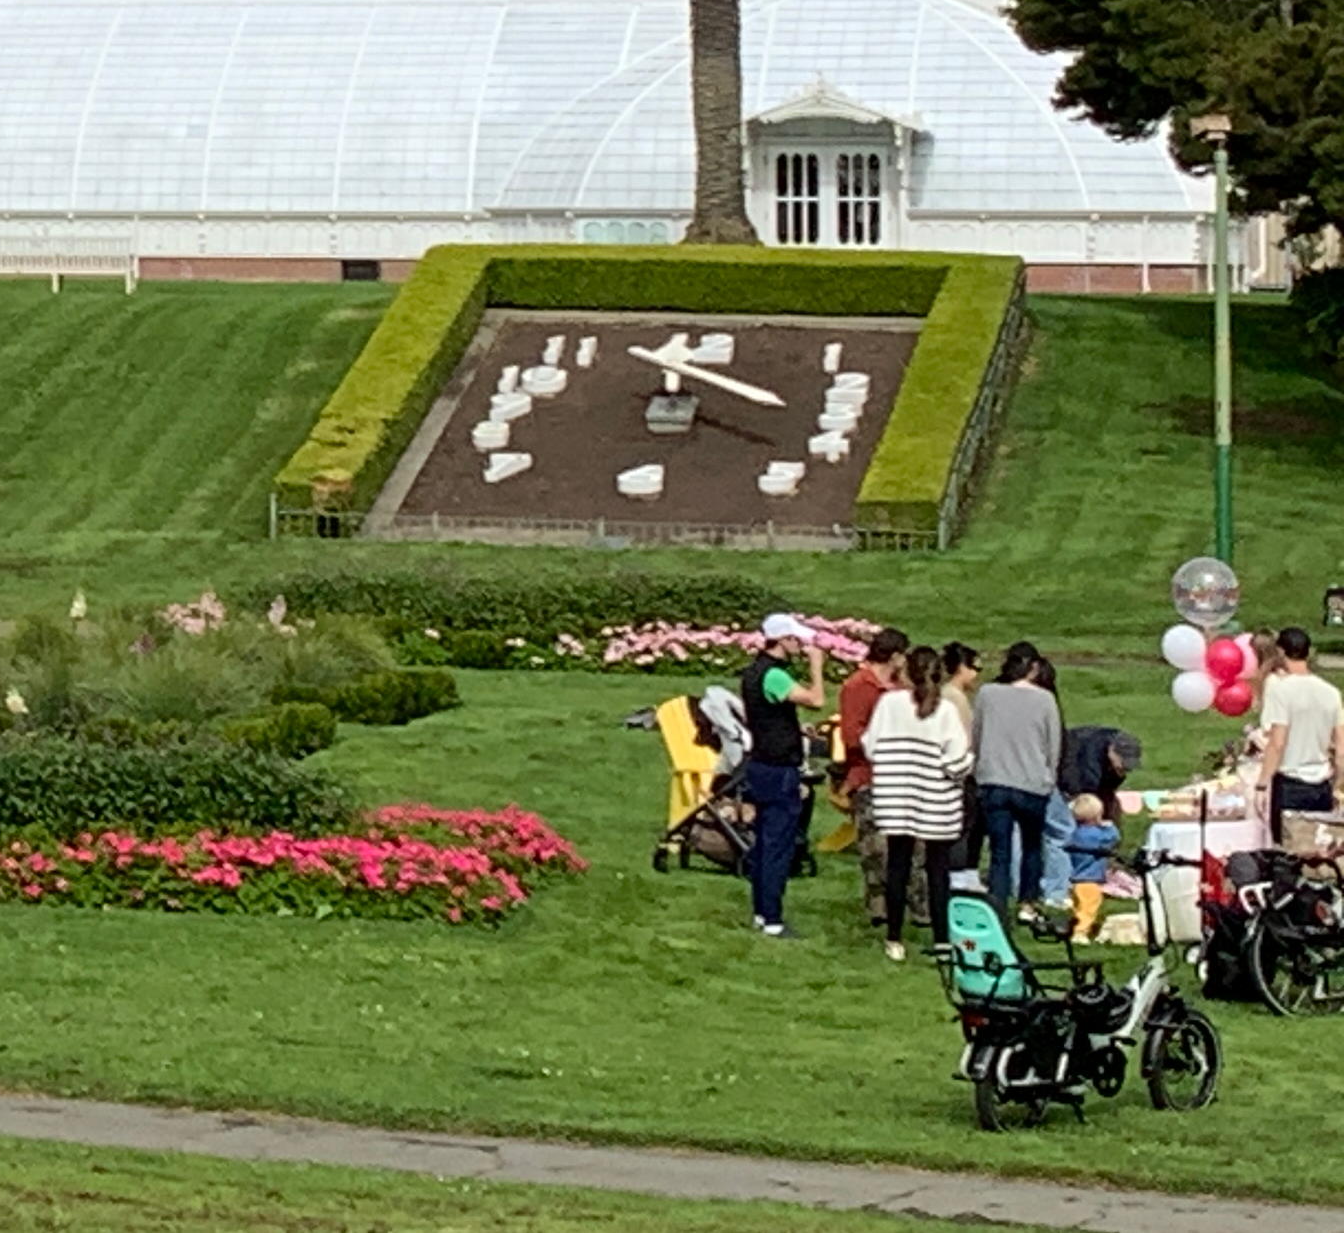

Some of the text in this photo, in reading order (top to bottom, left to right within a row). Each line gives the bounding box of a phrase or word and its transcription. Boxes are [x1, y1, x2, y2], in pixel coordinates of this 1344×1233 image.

[497, 365, 568, 395] 10
[808, 430, 850, 463] 4
[483, 452, 533, 483] 7
